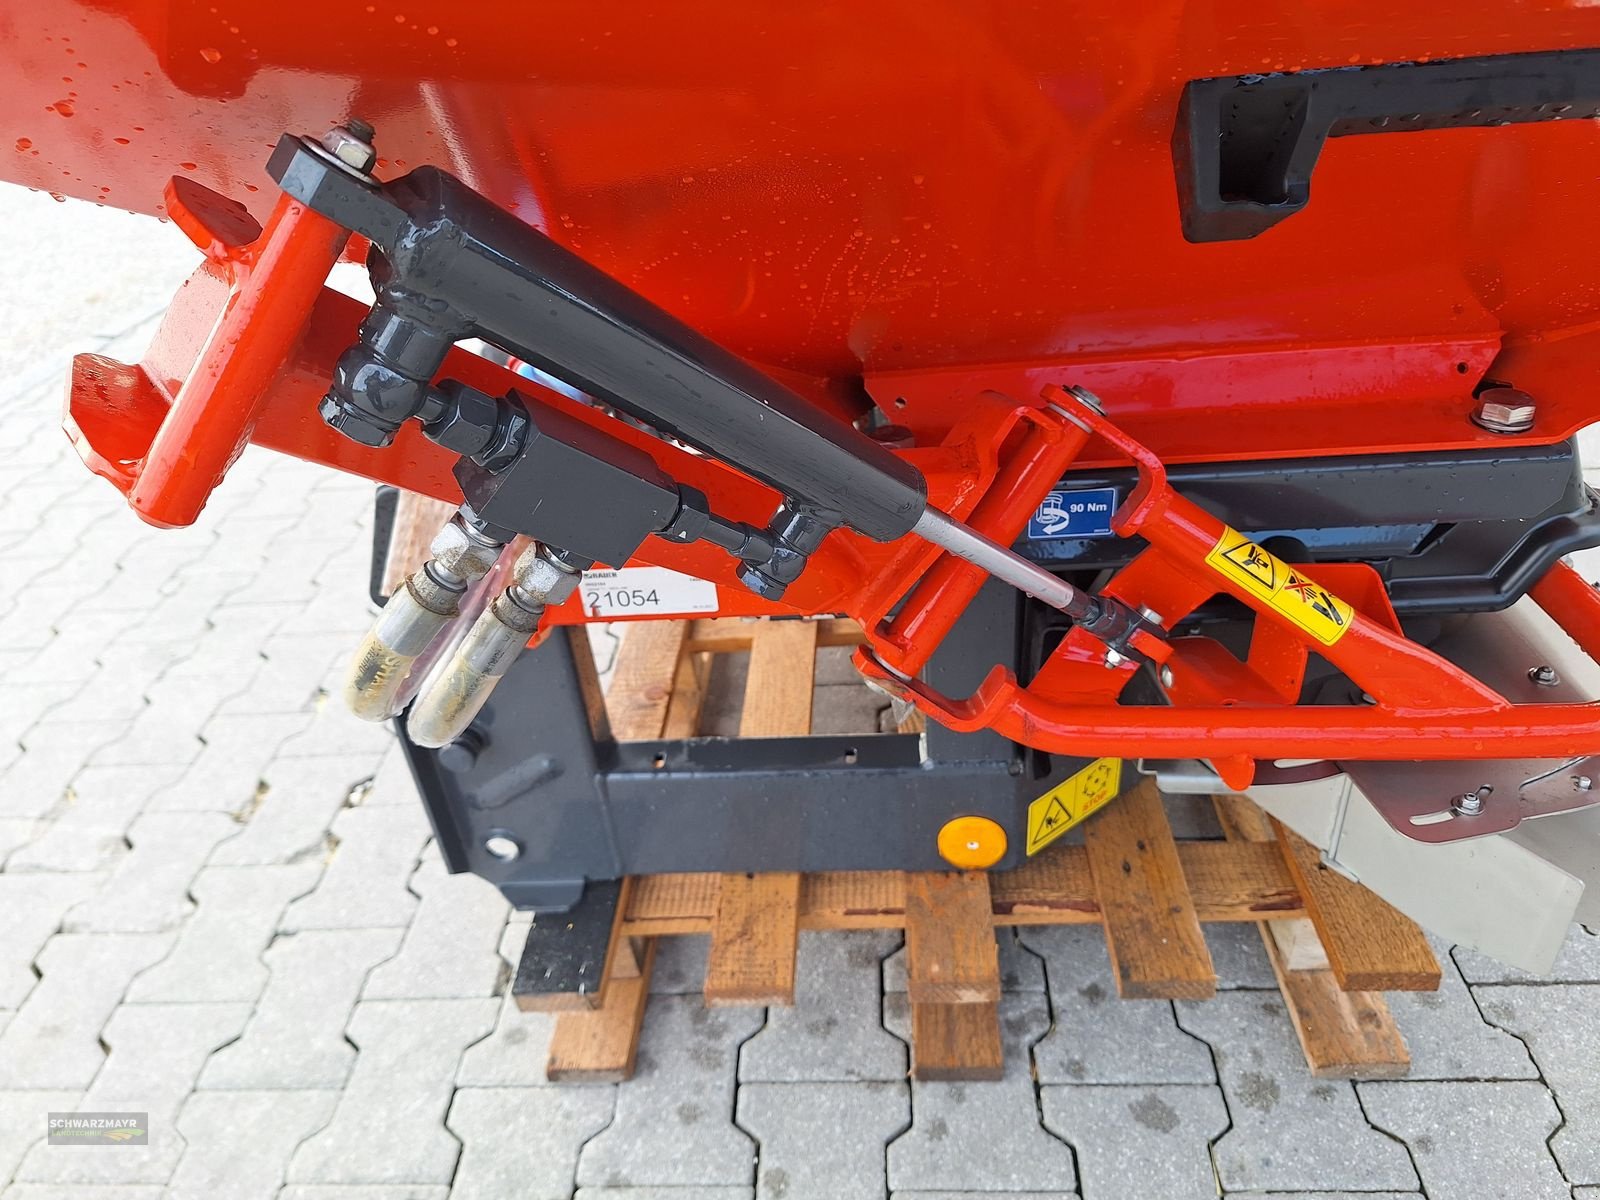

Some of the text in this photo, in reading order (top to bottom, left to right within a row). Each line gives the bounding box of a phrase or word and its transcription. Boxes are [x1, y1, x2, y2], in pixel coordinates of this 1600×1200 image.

[1070, 503, 1107, 513] 90 Nm
[587, 589, 660, 608] 21054
[1082, 790, 1107, 811] STOP
